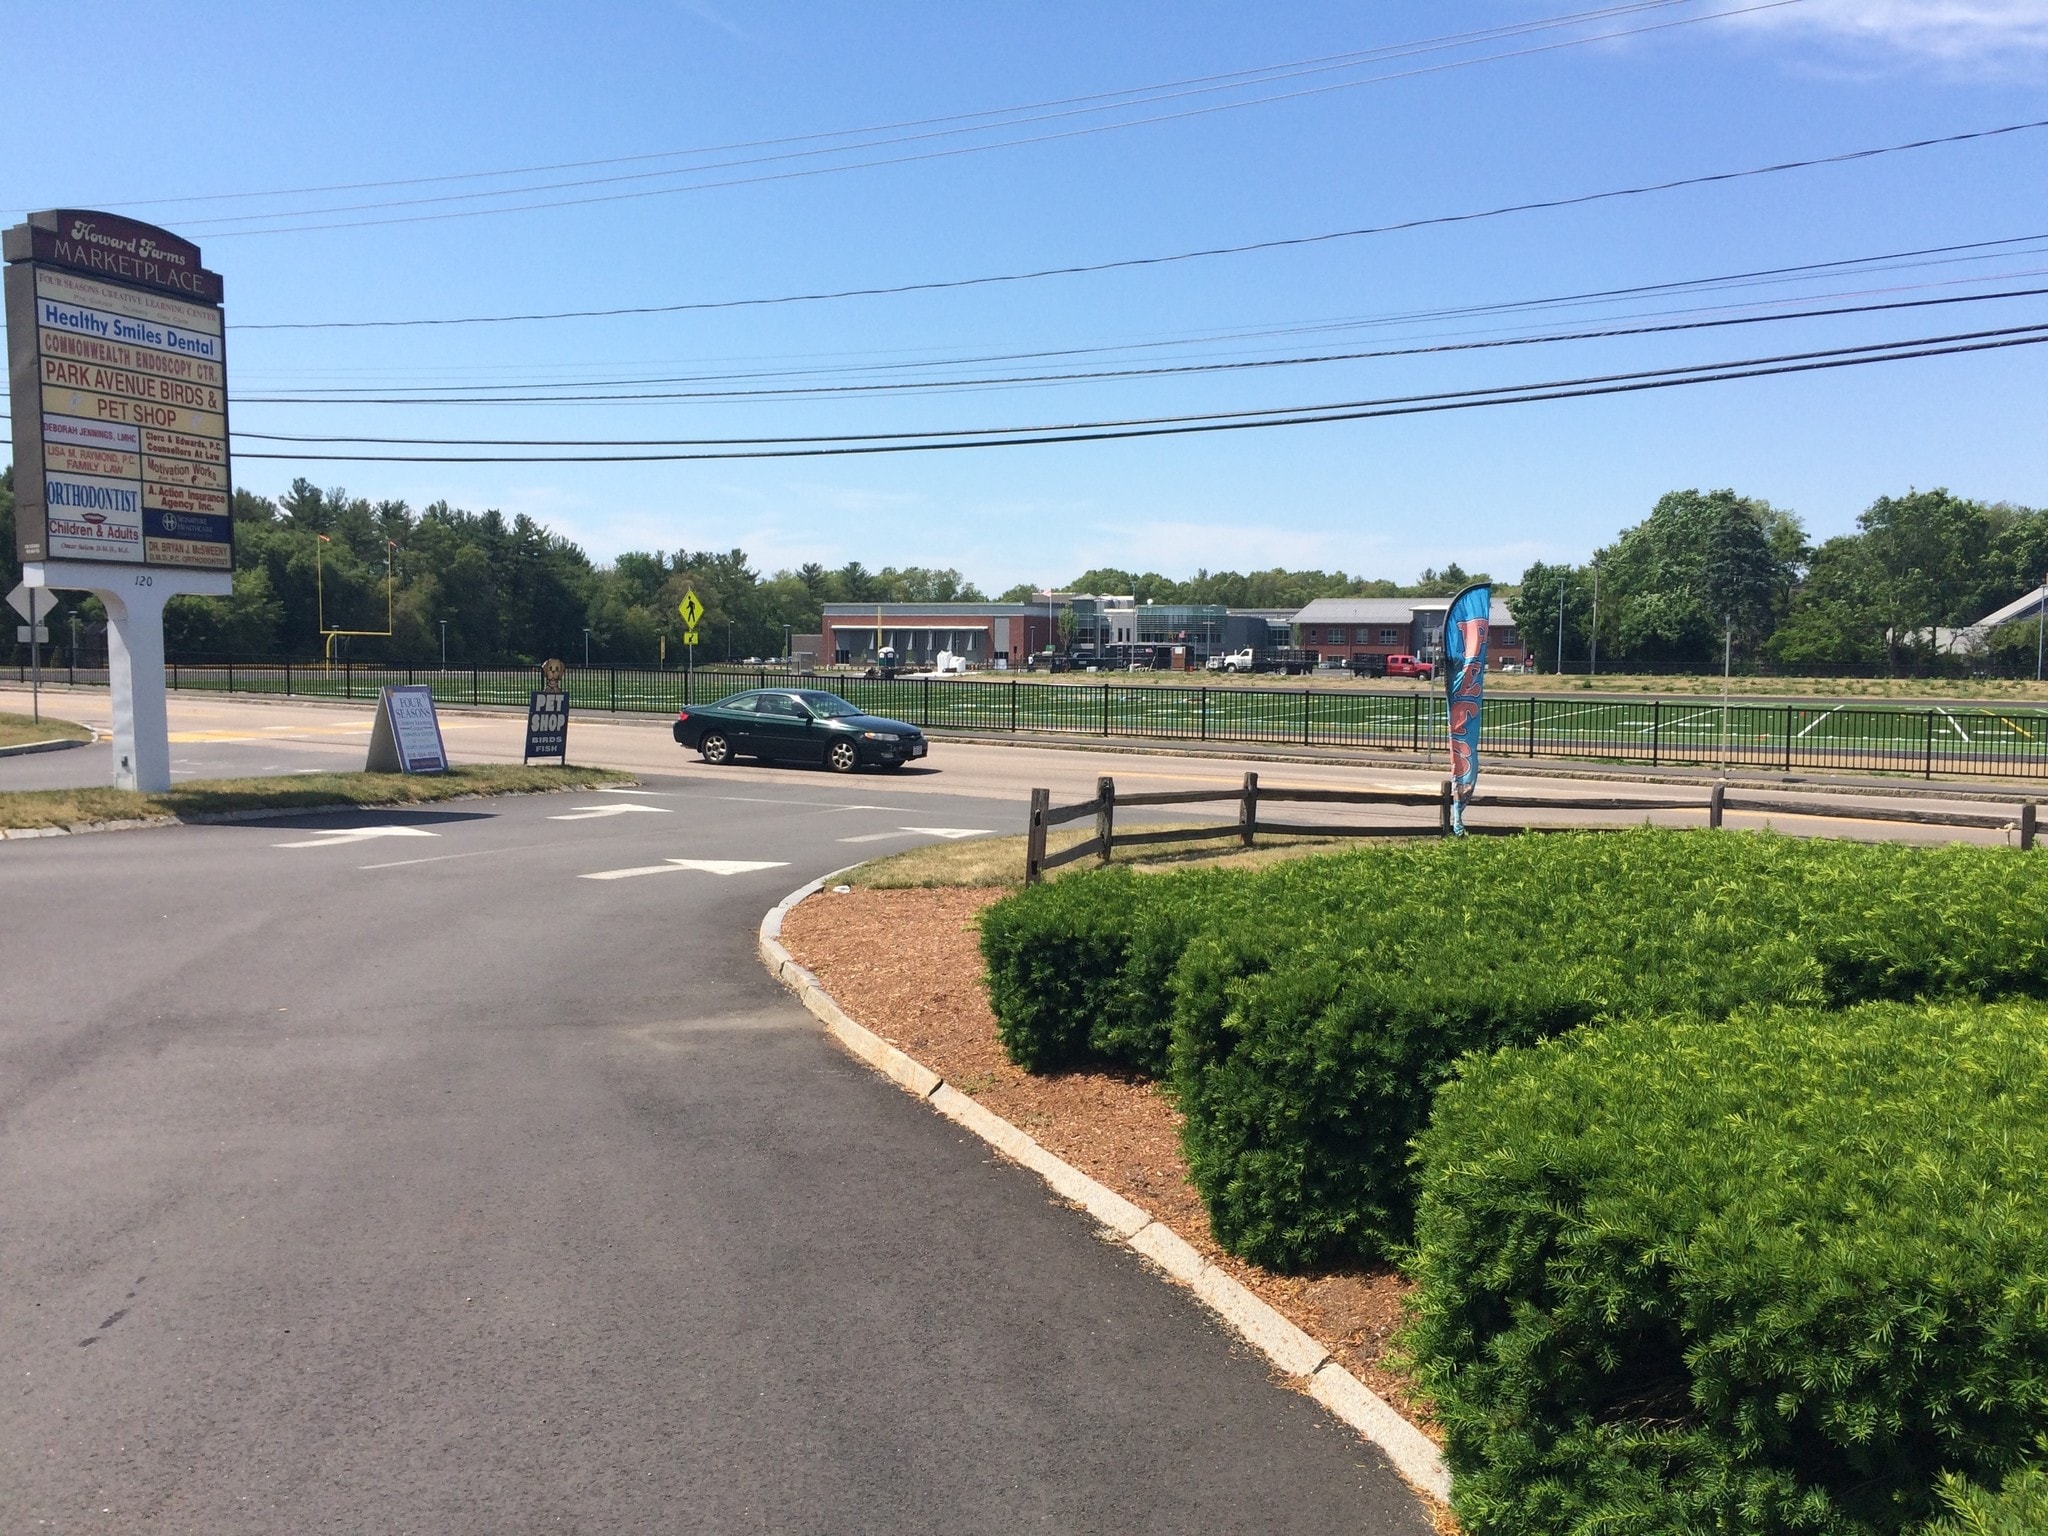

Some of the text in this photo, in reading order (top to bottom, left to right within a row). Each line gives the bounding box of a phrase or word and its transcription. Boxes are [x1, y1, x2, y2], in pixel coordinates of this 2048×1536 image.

[71, 220, 186, 266] Howard Farms
[54, 240, 205, 294] MARKETPLACE
[63, 280, 99, 294] SEASONS
[101, 288, 144, 305] CREATIVE
[145, 299, 185, 315] LEARNING
[187, 308, 217, 322] CENTER
[46, 305, 108, 336] Healthy
[114, 319, 162, 345] Smiles
[167, 331, 214, 356] Dental
[45, 334, 218, 382] COMMONWEALTH ENDOSCOPY CTR.
[46, 361, 217, 409] PARK AVENUE BIRDS &
[98, 399, 177, 427] PET SHOP
[44, 423, 78, 435] DEBORAH
[168, 435, 173, 443] &
[48, 446, 65, 456] LISA
[147, 443, 220, 461] Counsellors At Law
[67, 460, 123, 474] FAMILY LAW
[148, 457, 189, 475] Motivation
[192, 463, 217, 481] Works
[47, 481, 137, 512] ORTHODONTIST
[159, 486, 184, 498] Action
[188, 490, 226, 503] Insurance
[161, 497, 214, 511] Agency Inc.
[49, 520, 139, 541] Children & Adults
[162, 542, 184, 553] BRYAN
[135, 576, 153, 587] 120
[400, 698, 423, 708] FOUR
[536, 694, 565, 711] PET
[395, 708, 431, 719] SEASONS
[531, 714, 566, 732] SHOP
